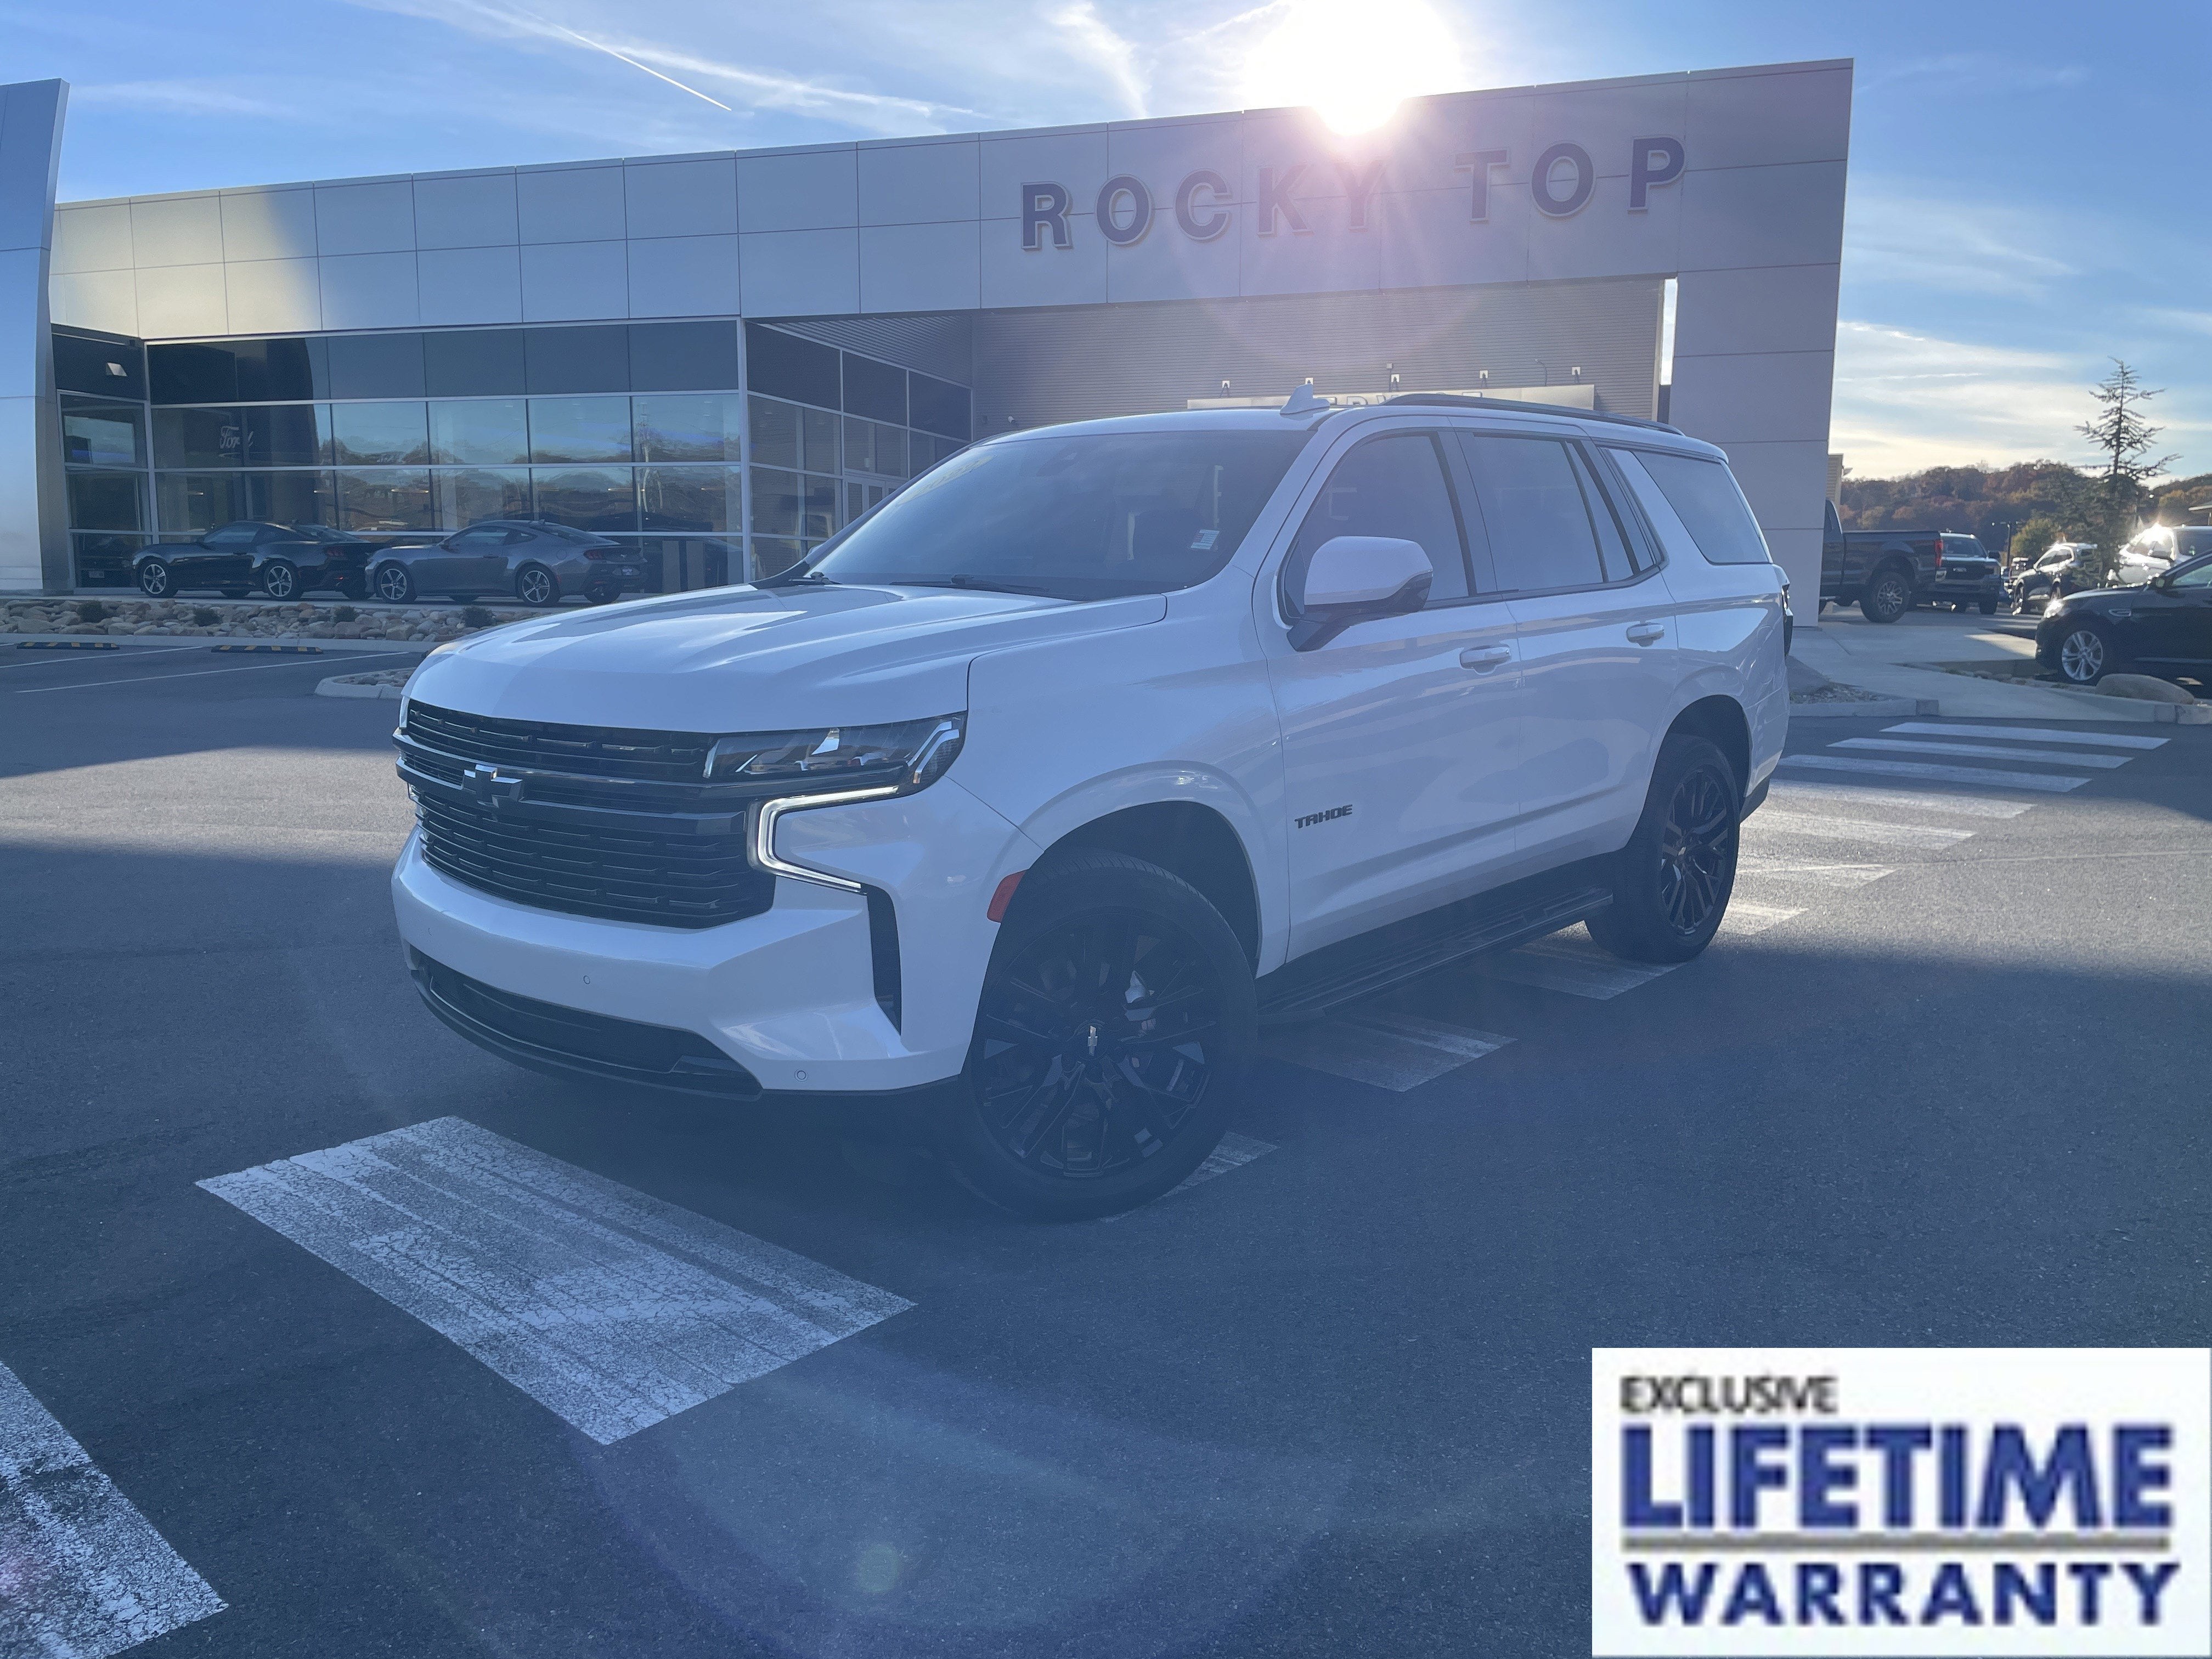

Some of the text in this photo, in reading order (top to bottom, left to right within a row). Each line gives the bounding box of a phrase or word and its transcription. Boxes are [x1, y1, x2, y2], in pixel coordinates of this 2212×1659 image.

[1020, 135, 1686, 250] ROCKY TOP
[1294, 804, 1353, 829] TAHOE
